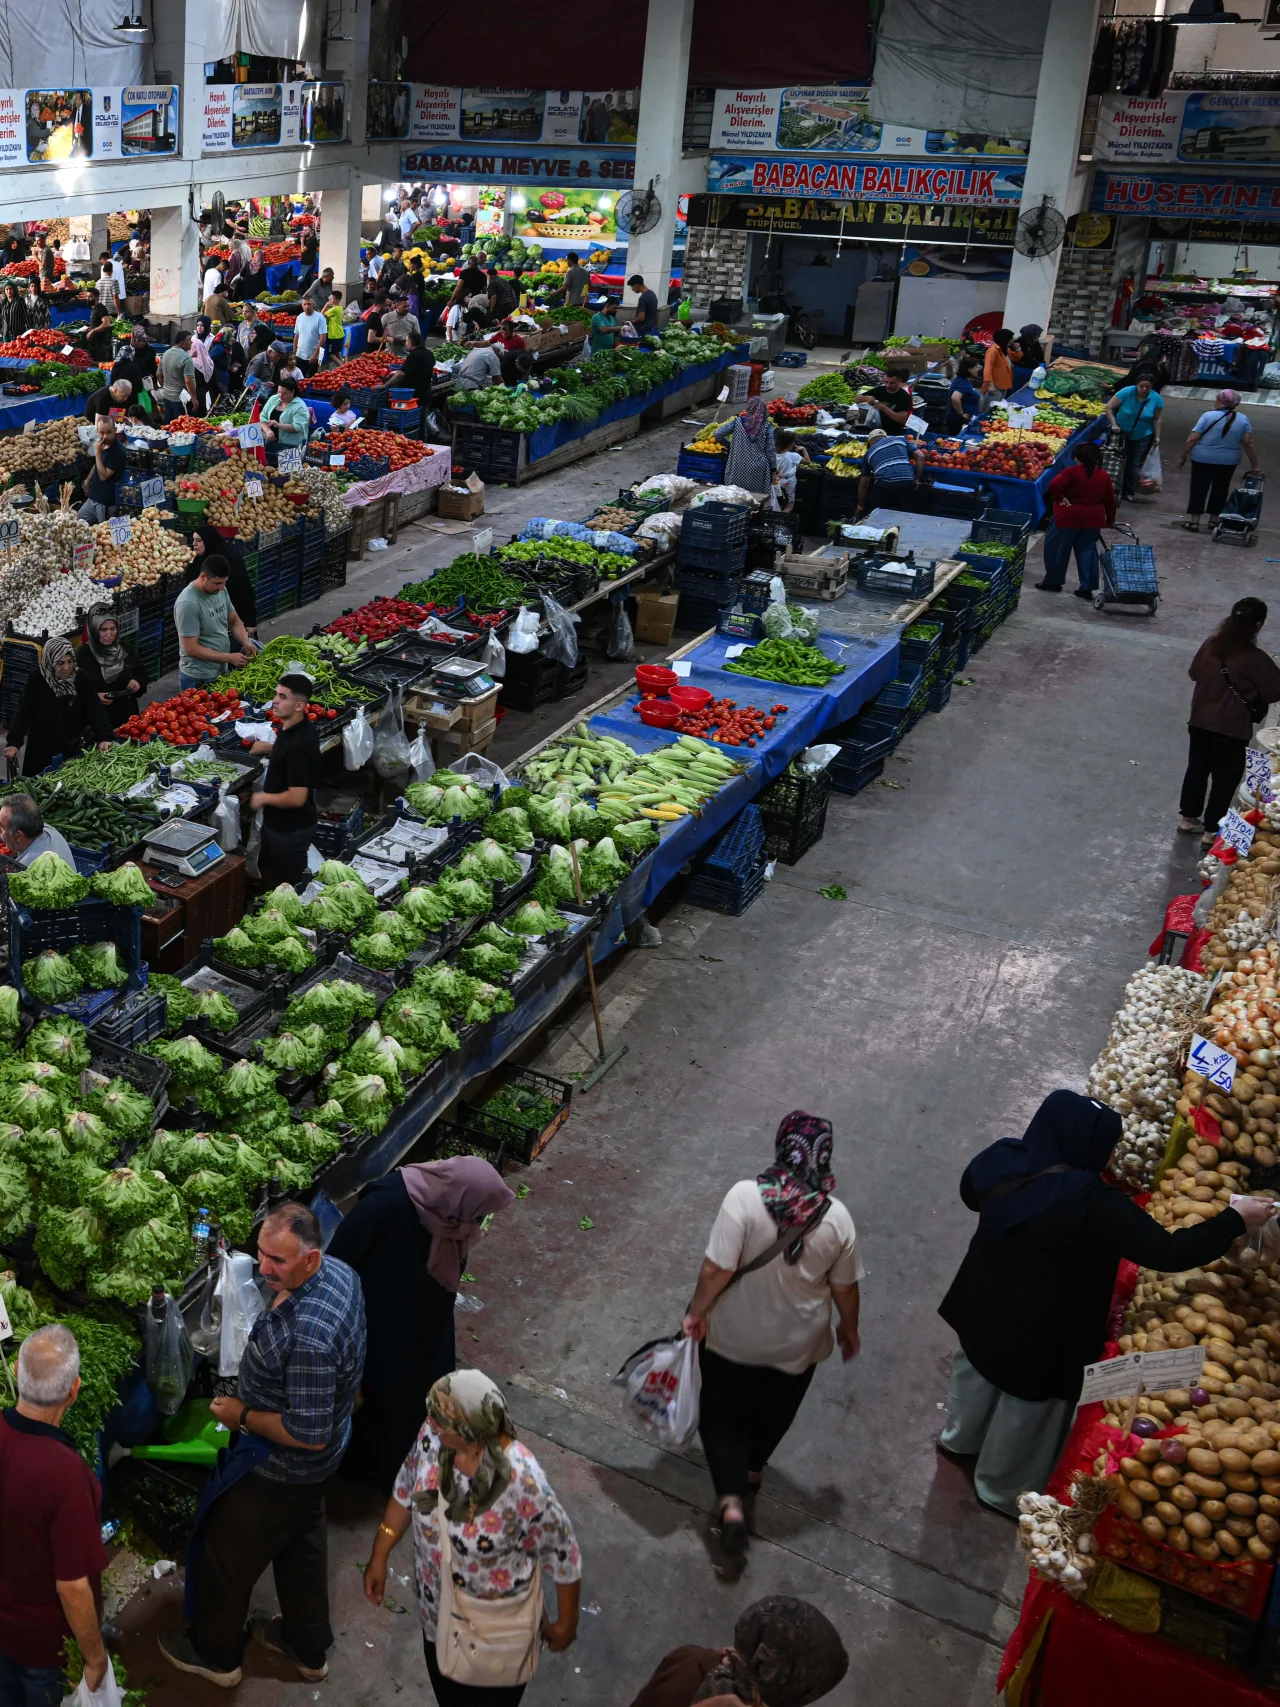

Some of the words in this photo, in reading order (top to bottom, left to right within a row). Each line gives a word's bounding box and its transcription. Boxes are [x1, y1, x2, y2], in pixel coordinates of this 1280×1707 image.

[147, 90, 168, 100] OTOPARK
[209, 91, 227, 104] Hayırlı
[423, 88, 450, 100] Hayırlı
[735, 92, 767, 105] Hayırlı
[790, 88, 815, 100] ÜÇPINAR
[815, 89, 838, 98] DÜĞÜN
[839, 90, 863, 98] SALONU
[415, 100, 457, 111] Alışverişler
[1127, 97, 1167, 112] Hayırlı
[1208, 95, 1250, 109] GENÇLİK
[203, 104, 231, 118] Alışverişler
[420, 110, 451, 121] Dilerim.
[724, 104, 775, 118] Alışverişler
[207, 117, 227, 128] Dilerim.
[729, 116, 766, 128] Dilerim.
[1112, 112, 1178, 127] Alışverişler
[720, 130, 740, 138] Mürsel
[740, 131, 772, 139] YILDIZKAYA
[1119, 125, 1166, 138] Dilerim.
[1107, 140, 1132, 149] Mürsel
[1132, 141, 1173, 150] YILDIZKAYA
[404, 154, 496, 174] BABACAN
[500, 158, 571, 176] MEYVE
[577, 160, 593, 178] &
[753, 163, 857, 192] BABACAN
[863, 166, 999, 201] BALIKÇILIK
[842, 191, 866, 199] EYÜP
[1104, 178, 1261, 207] HÜSEYİN
[1103, 203, 1151, 212] DENİZ
[1155, 204, 1237, 216] ÜRÜNLERİ
[745, 218, 770, 227] EYÜP
[772, 219, 803, 230] YÜCEL
[1191, 229, 1223, 239] OSMAN
[238, 425, 259, 442] 10
[279, 461, 295, 473] 50
[143, 479, 164, 499] 10
[246, 481, 259, 495] 10
[112, 527, 126, 546] 10
[1245, 755, 1254, 769] 3
[1259, 766, 1271, 780] 50
[1246, 774, 1256, 788] 6
[1228, 810, 1254, 836] AFYON
[1191, 1040, 1210, 1067] 4
[1214, 1071, 1233, 1090] 50
